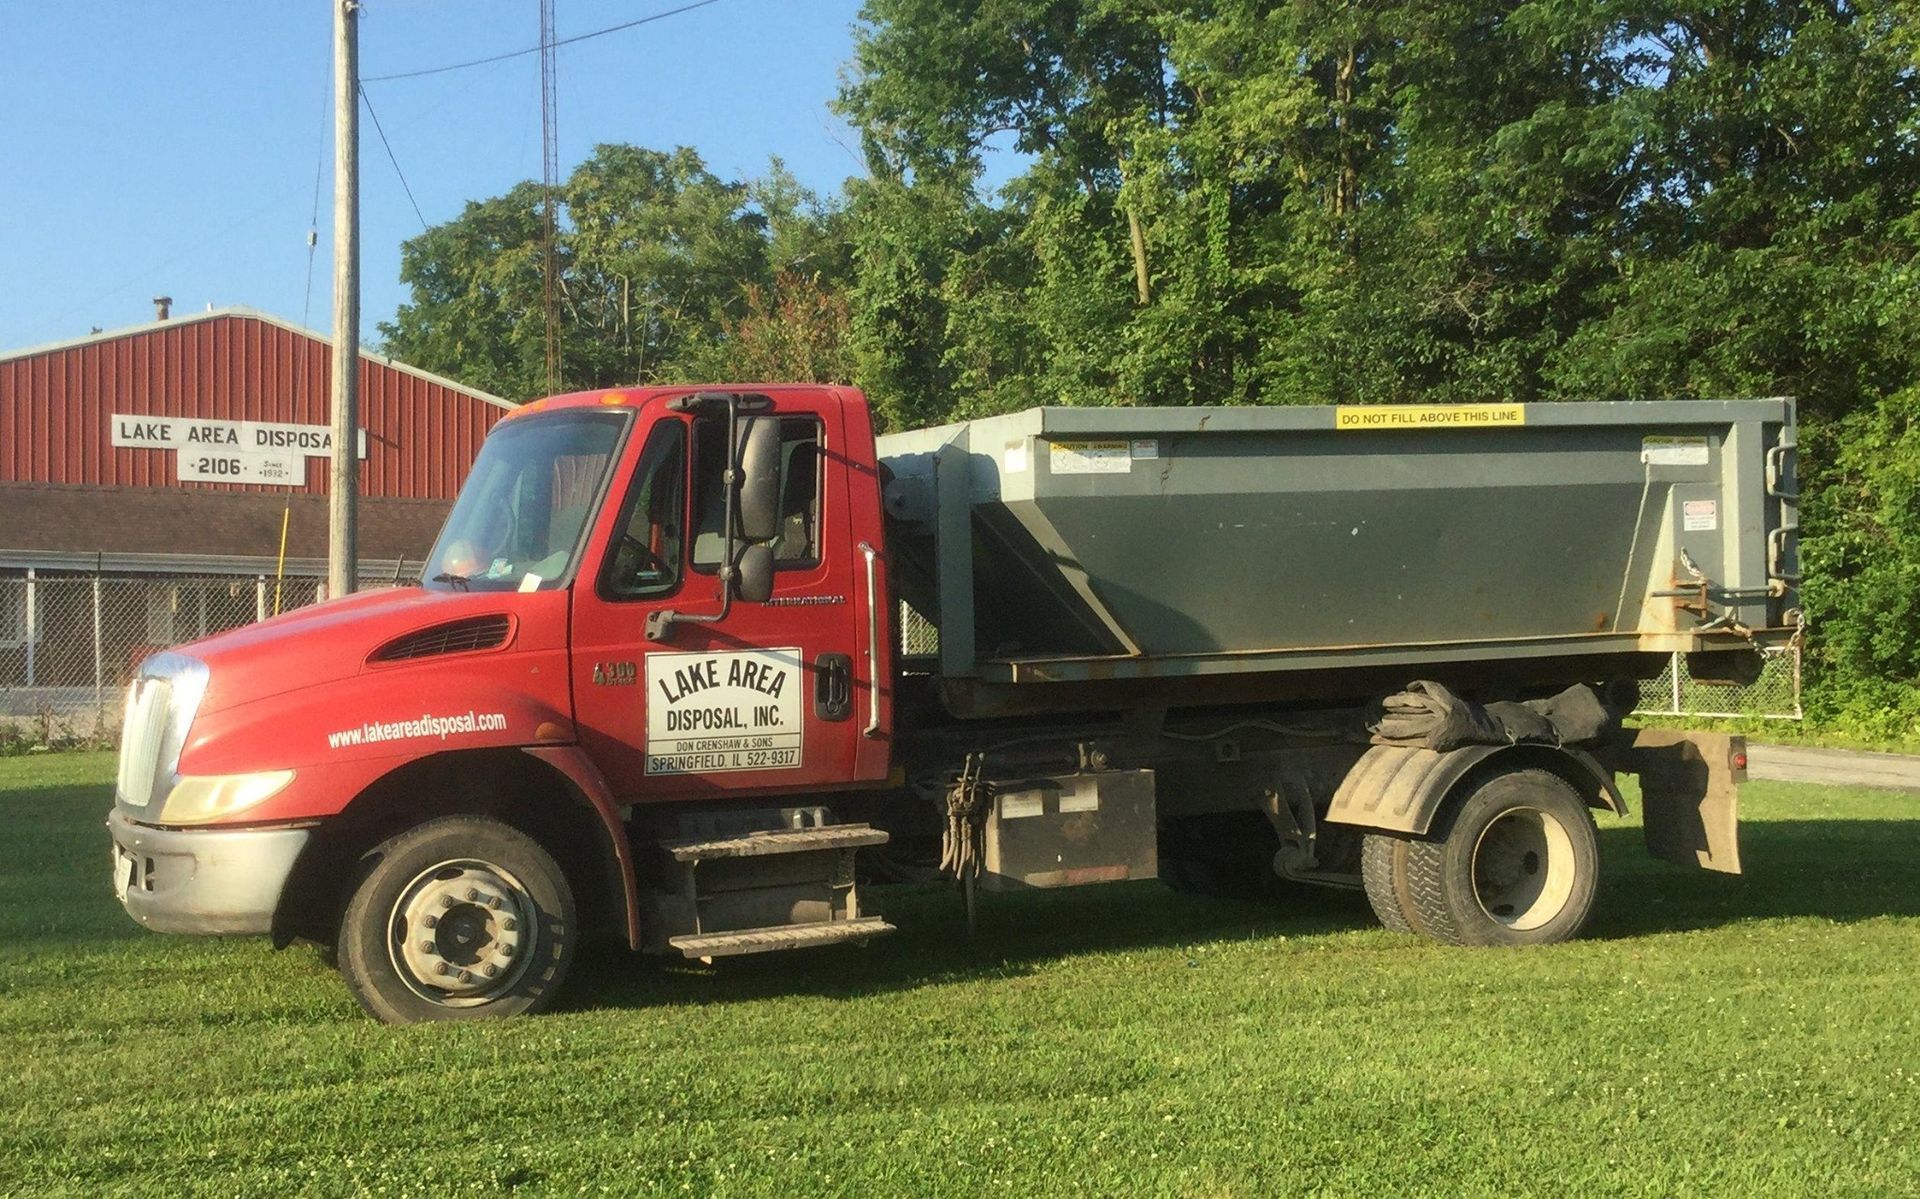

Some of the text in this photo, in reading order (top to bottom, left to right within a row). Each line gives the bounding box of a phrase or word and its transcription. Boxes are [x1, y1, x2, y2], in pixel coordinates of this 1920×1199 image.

[1342, 410, 1518, 425] DO NOT FILL ABOVE THIS LINE
[121, 422, 331, 449] LAKE AREA DISPOSA
[198, 457, 241, 476] 2106
[659, 658, 787, 704] LAKE AREA
[328, 710, 507, 748] www.lakeareadisposal.com
[666, 704, 784, 732] DISPOSAL, INC.
[676, 737, 773, 752] DON CRENSHAW & SONS
[732, 753, 742, 767] IL
[747, 750, 796, 766] 522-9317
